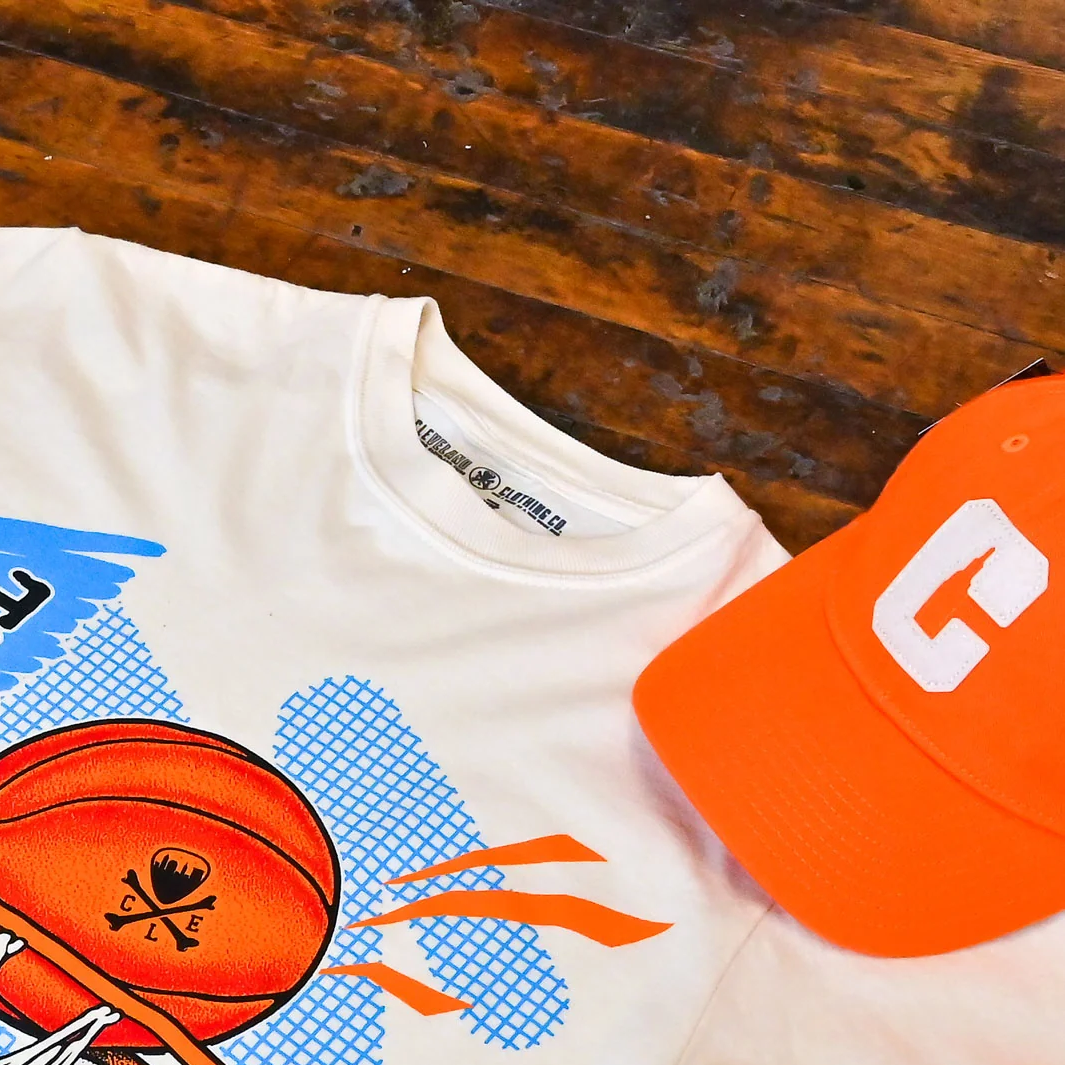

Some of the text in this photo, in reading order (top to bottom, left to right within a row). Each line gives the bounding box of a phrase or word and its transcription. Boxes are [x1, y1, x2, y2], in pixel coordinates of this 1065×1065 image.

[498, 486, 551, 521] CLOTHING
[547, 514, 568, 534] CO.
[872, 498, 1049, 692] C
